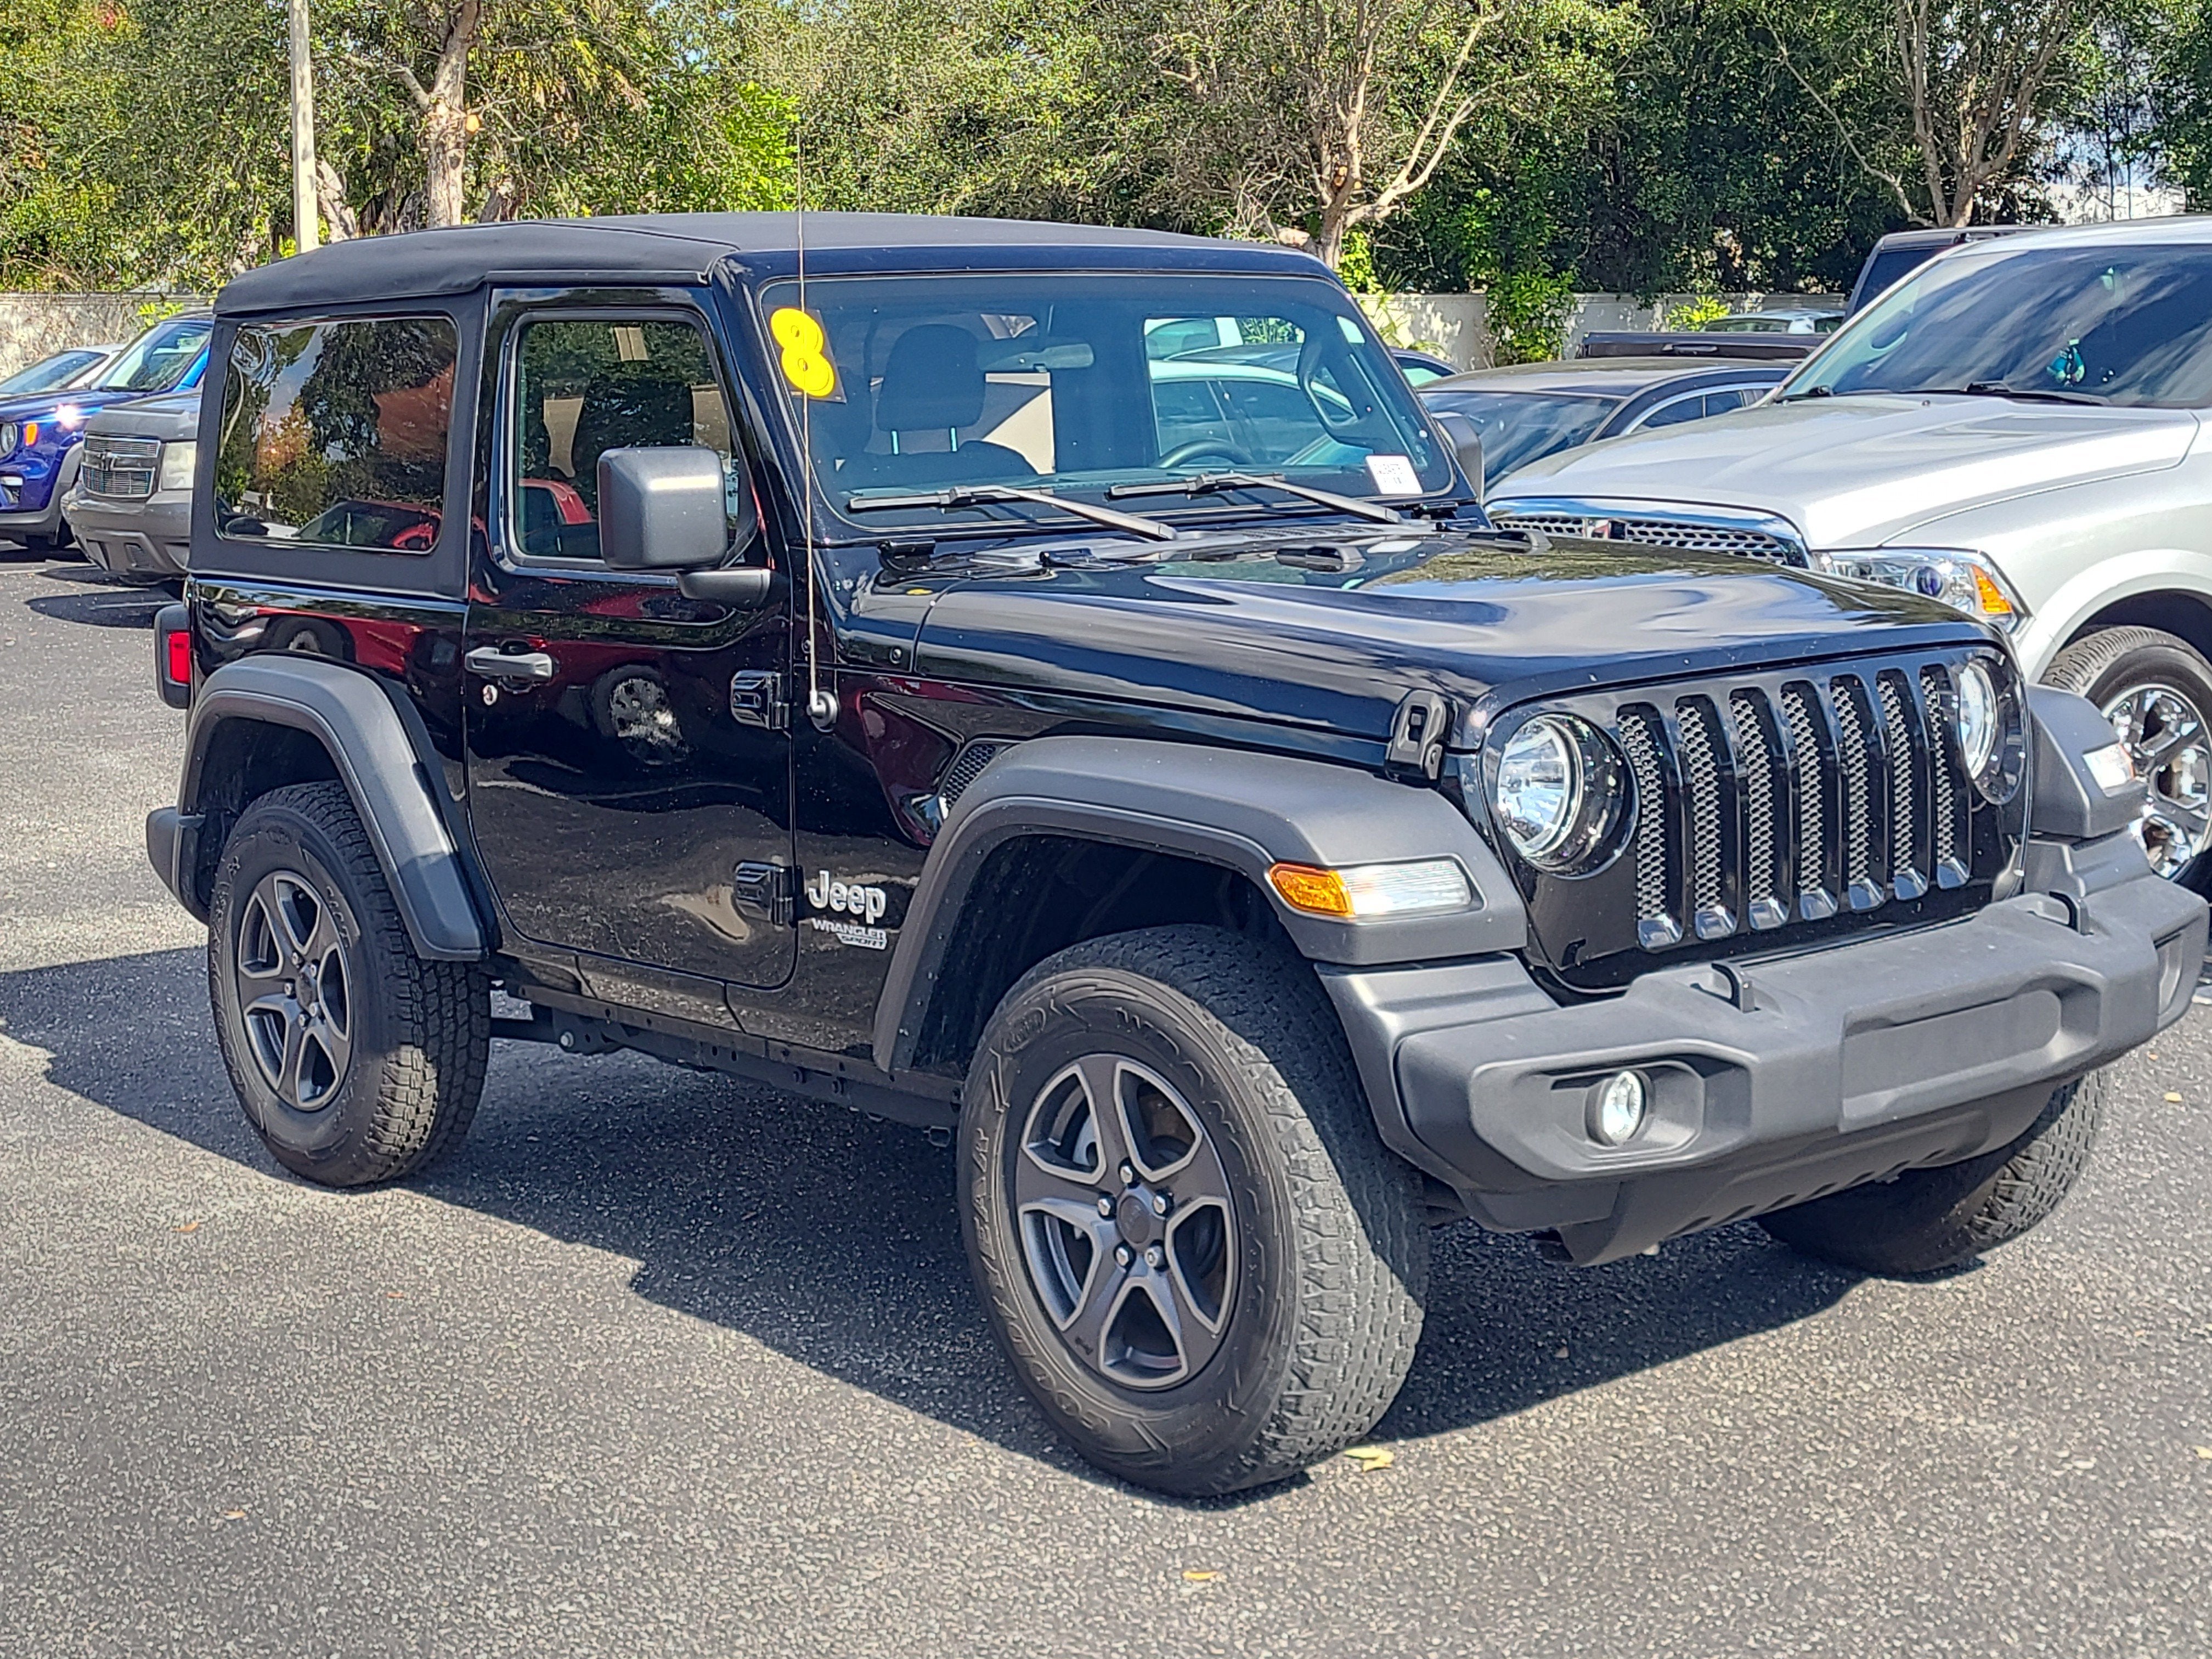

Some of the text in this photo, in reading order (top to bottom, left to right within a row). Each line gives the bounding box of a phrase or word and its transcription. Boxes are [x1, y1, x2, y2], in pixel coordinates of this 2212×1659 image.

[770, 308, 834, 397] 8
[809, 870, 886, 924] Jeep
[811, 917, 887, 940] WRANGLER
[840, 935, 884, 947] SPORT
